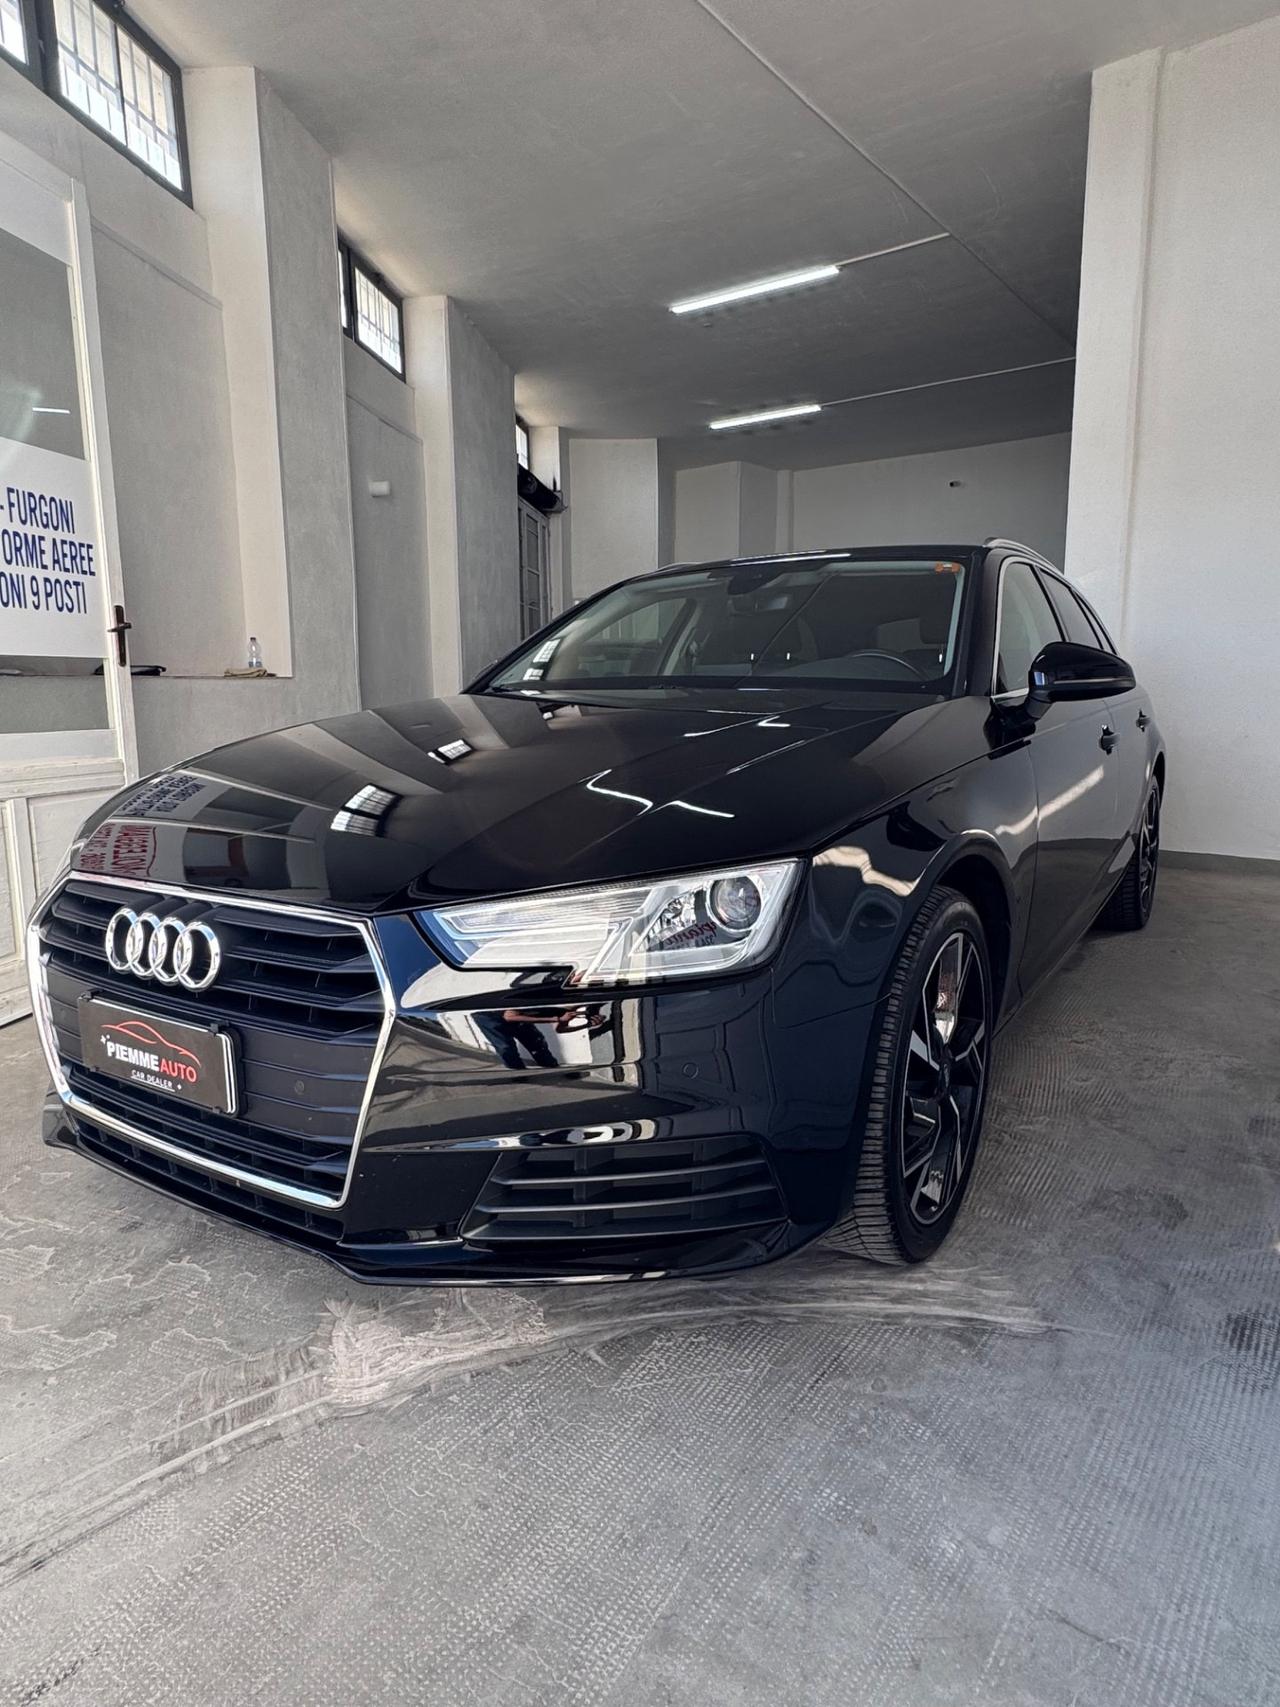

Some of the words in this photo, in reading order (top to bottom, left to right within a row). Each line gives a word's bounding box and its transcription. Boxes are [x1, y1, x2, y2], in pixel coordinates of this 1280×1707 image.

[6, 486, 75, 534] FURGONI
[52, 538, 96, 577] AEREE
[30, 575, 41, 610] 9
[43, 577, 87, 615] POSTI
[131, 1069, 146, 1080] CAR
[146, 1074, 173, 1089] DEALER
